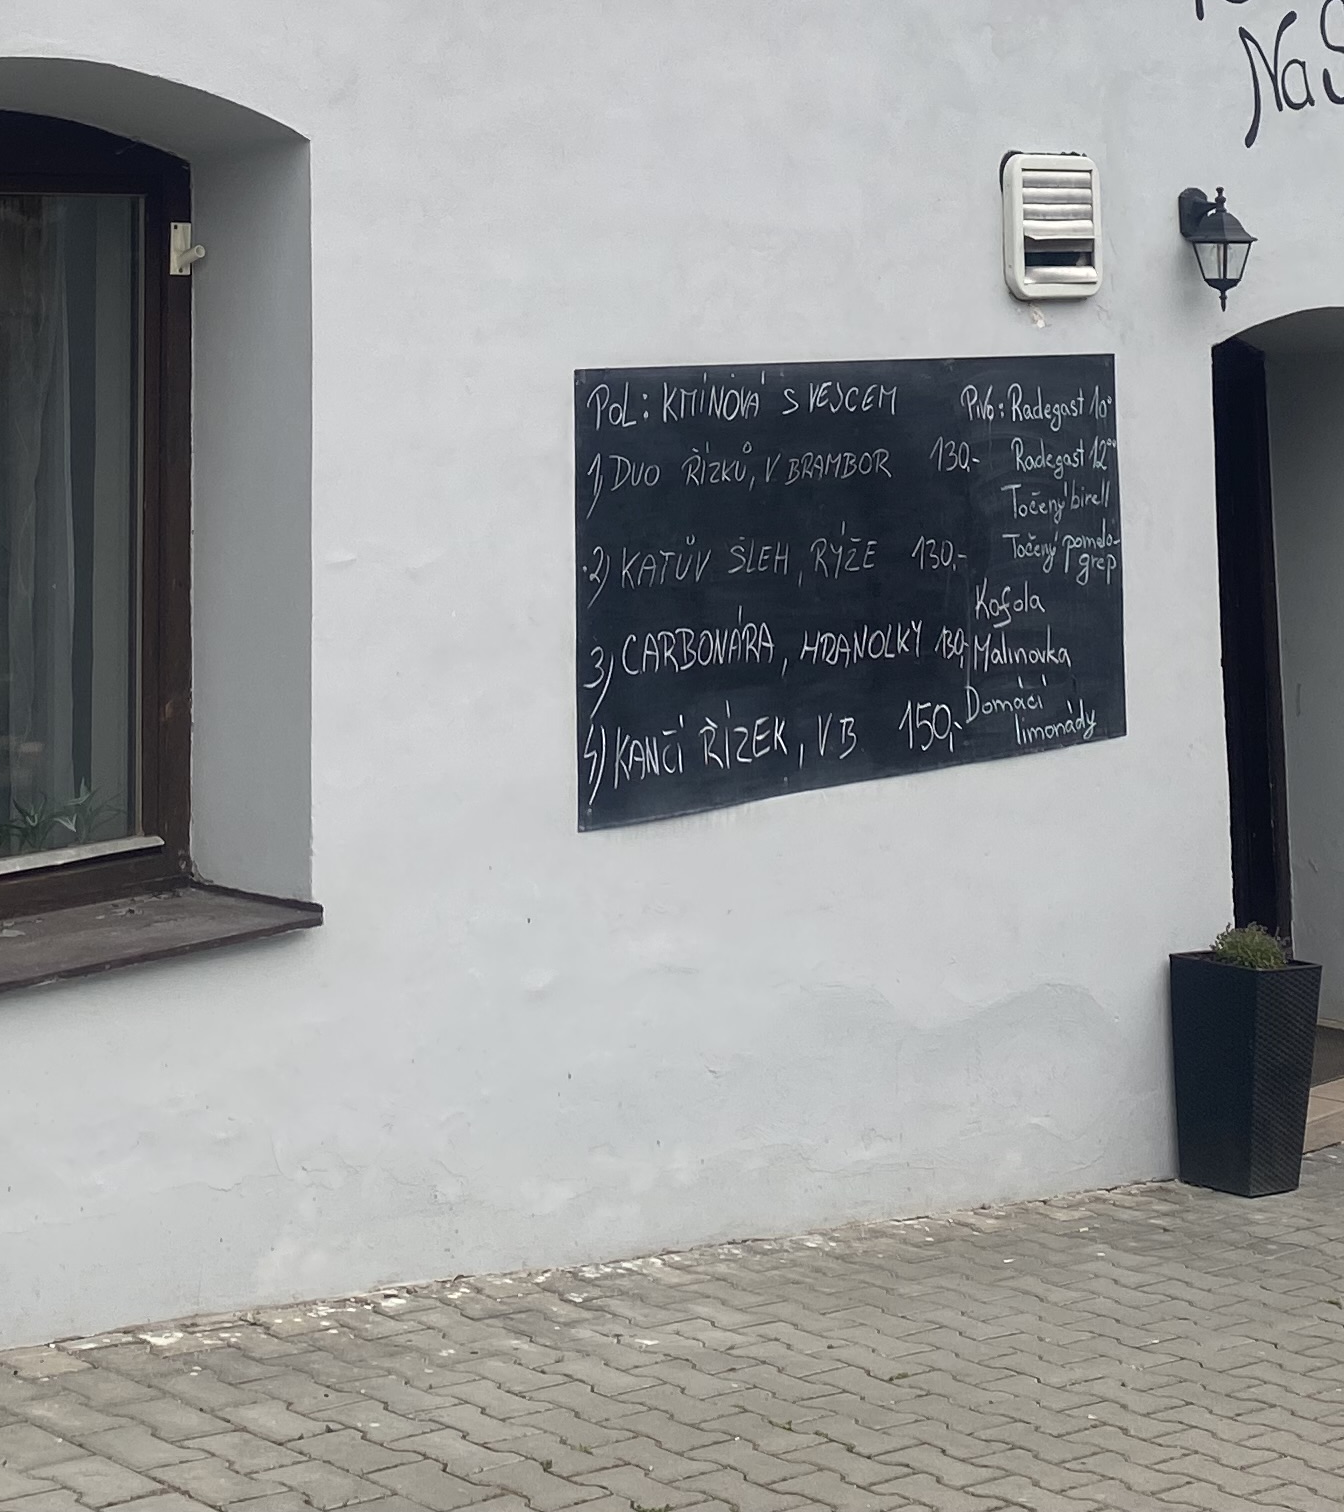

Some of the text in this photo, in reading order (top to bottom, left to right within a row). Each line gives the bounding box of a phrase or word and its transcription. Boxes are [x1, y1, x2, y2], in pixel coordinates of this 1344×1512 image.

[1238, 10, 1315, 149] Na
[782, 388, 799, 415] S
[809, 381, 897, 415] VEJCEM
[1007, 383, 1084, 432] Radegast
[609, 455, 660, 491] DUO
[784, 448, 892, 485] BRAMBOR
[1010, 437, 1085, 480] Radegast
[1001, 478, 1110, 524] Točený birell
[622, 534, 712, 589] KATŮV
[1002, 531, 1058, 573] Točený
[1076, 553, 1117, 585] grep
[975, 577, 1046, 628] Kofola
[800, 619, 923, 668] HRANOLKY
[974, 624, 1072, 672] Malinovka
[966, 674, 1047, 723] Domácí
[1014, 698, 1097, 745] limonády
[614, 714, 684, 789] KANČÍ
